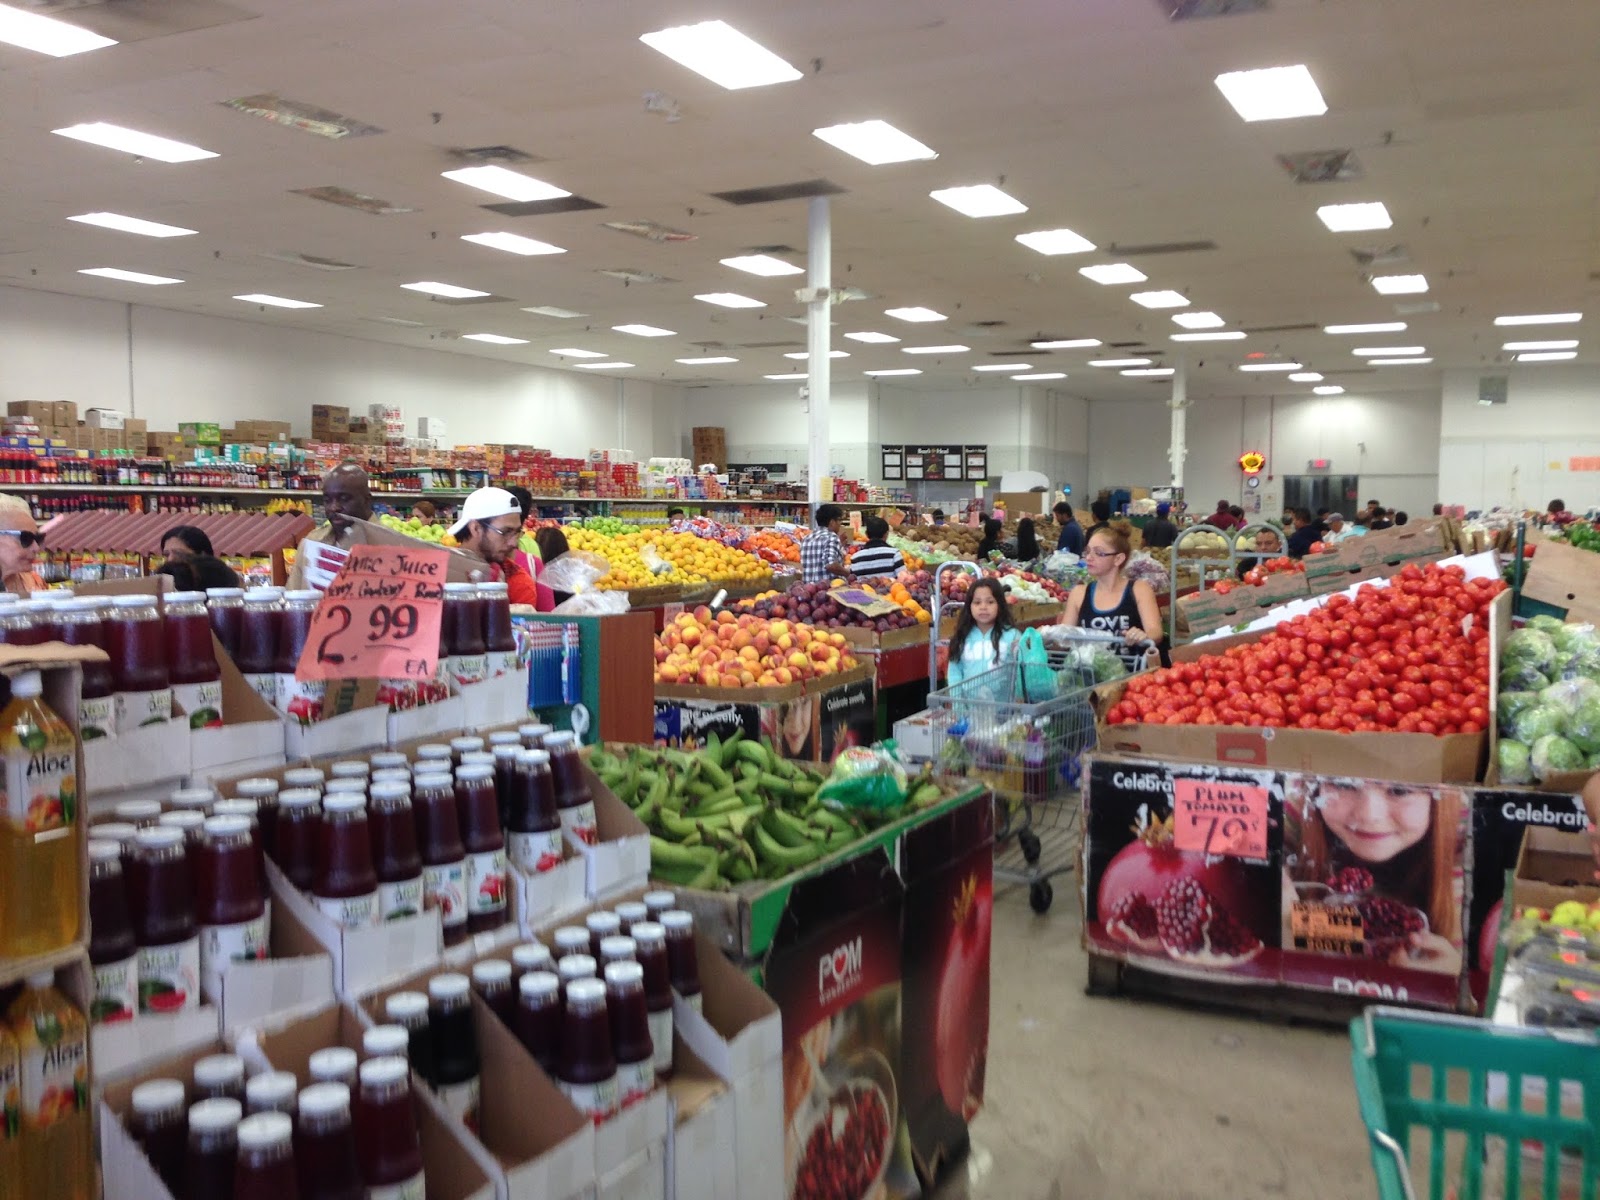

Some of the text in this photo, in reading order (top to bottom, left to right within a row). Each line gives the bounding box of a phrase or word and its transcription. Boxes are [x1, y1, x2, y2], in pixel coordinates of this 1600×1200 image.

[391, 555, 439, 576] Juice
[405, 660, 428, 675] EA
[27, 752, 71, 776] Aloe
[1113, 771, 1176, 793] Celebra
[1194, 787, 1245, 801] PLUM
[1182, 801, 1251, 815] TOMATO
[818, 934, 863, 994] POM
